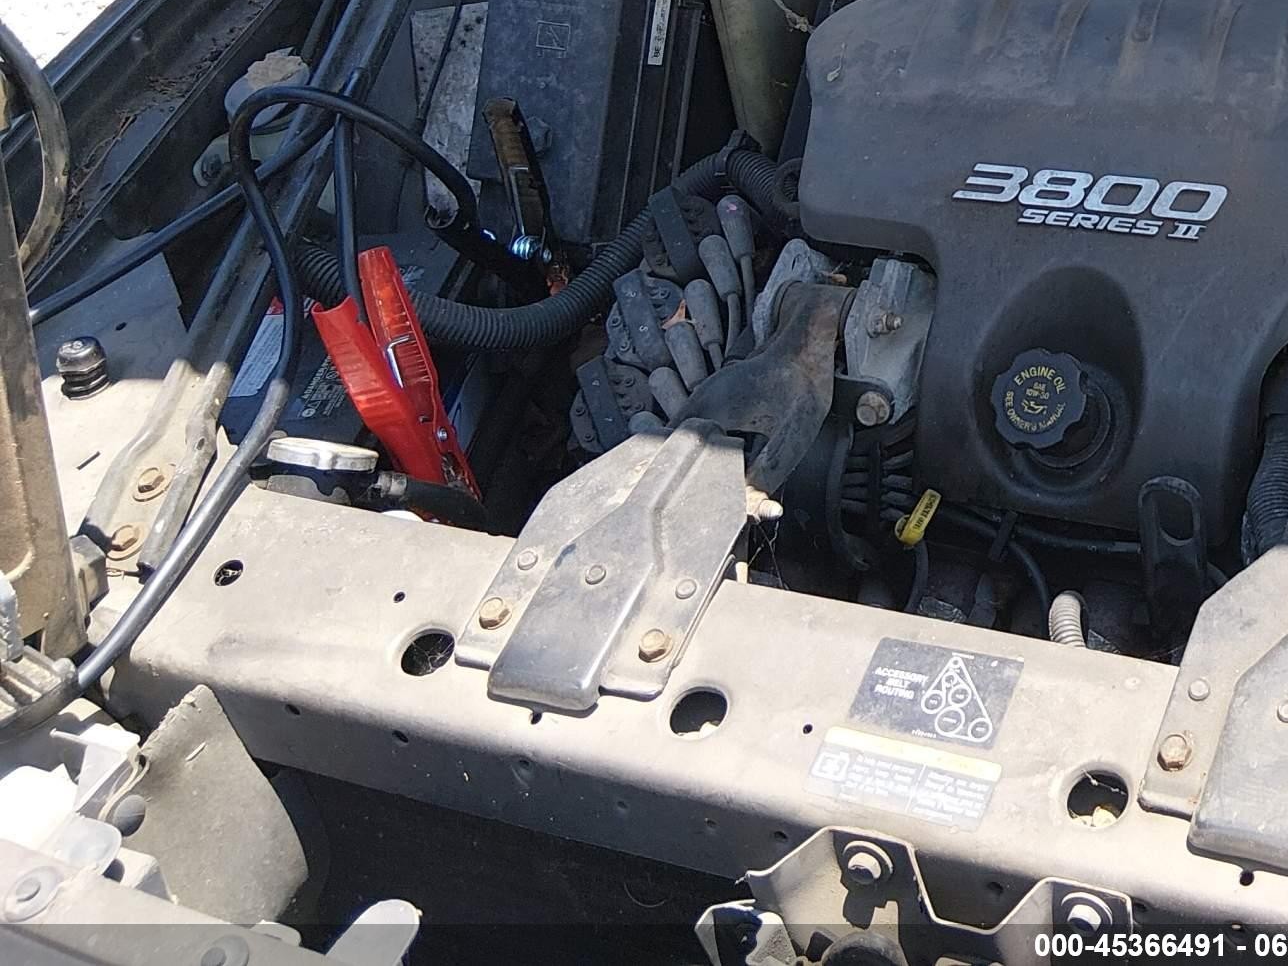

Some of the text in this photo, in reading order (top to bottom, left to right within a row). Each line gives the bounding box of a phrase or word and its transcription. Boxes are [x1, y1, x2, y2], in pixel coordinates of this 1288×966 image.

[952, 163, 1228, 222] 3800
[1017, 208, 1206, 240] SERIES II
[1013, 366, 1066, 394] ENGINE OIL
[1005, 391, 1014, 409] SEE
[1038, 402, 1067, 428] MANUAL
[874, 666, 929, 687] ACCESSORY
[885, 677, 911, 690] BELT
[873, 683, 915, 700] ROUTING
